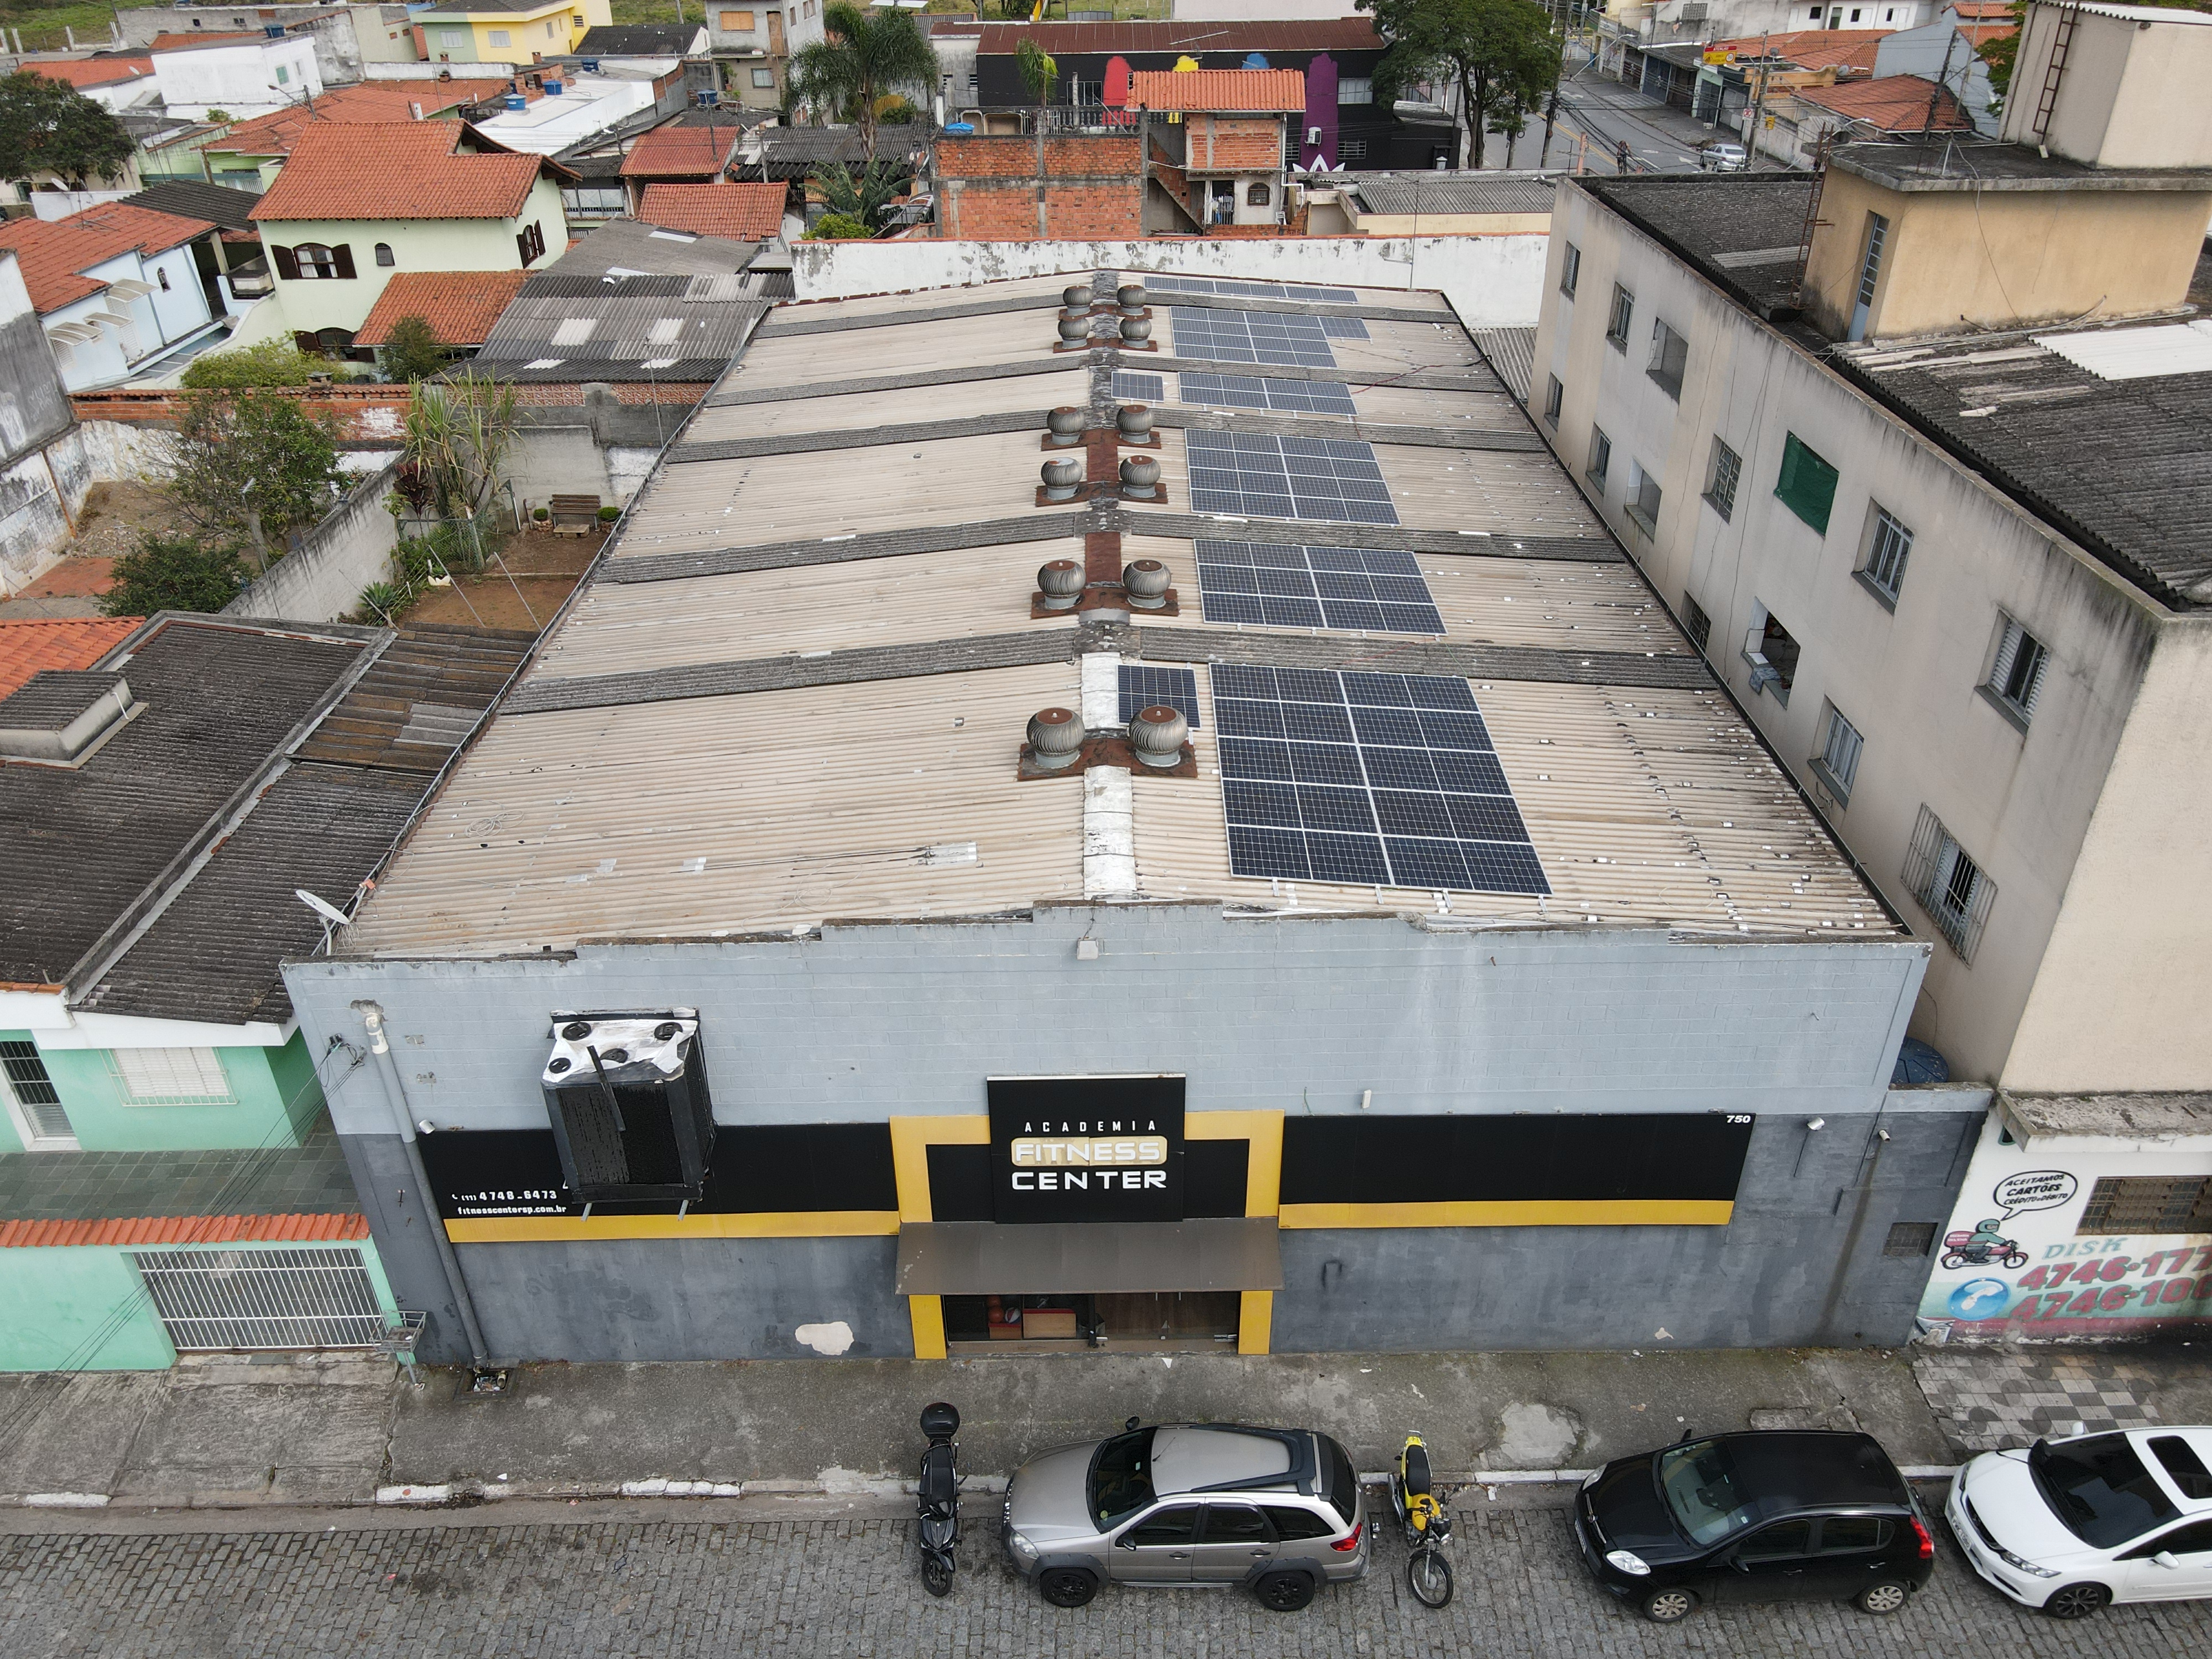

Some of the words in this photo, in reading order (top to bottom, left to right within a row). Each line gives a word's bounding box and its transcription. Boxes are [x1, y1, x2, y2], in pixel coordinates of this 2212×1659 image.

[1025, 1120, 1155, 1132] ACADEMIA
[1015, 1142, 1160, 1161] FITNESS
[1012, 1170, 1166, 1190] CENTER
[2005, 1174, 2064, 1187] ACEITAMOS
[2006, 1182, 2062, 1196] CARTÕES
[479, 1191, 557, 1201] 4748-6473
[457, 1205, 567, 1214] fitnesscentersp.com.br
[2042, 1238, 2128, 1260] DISK
